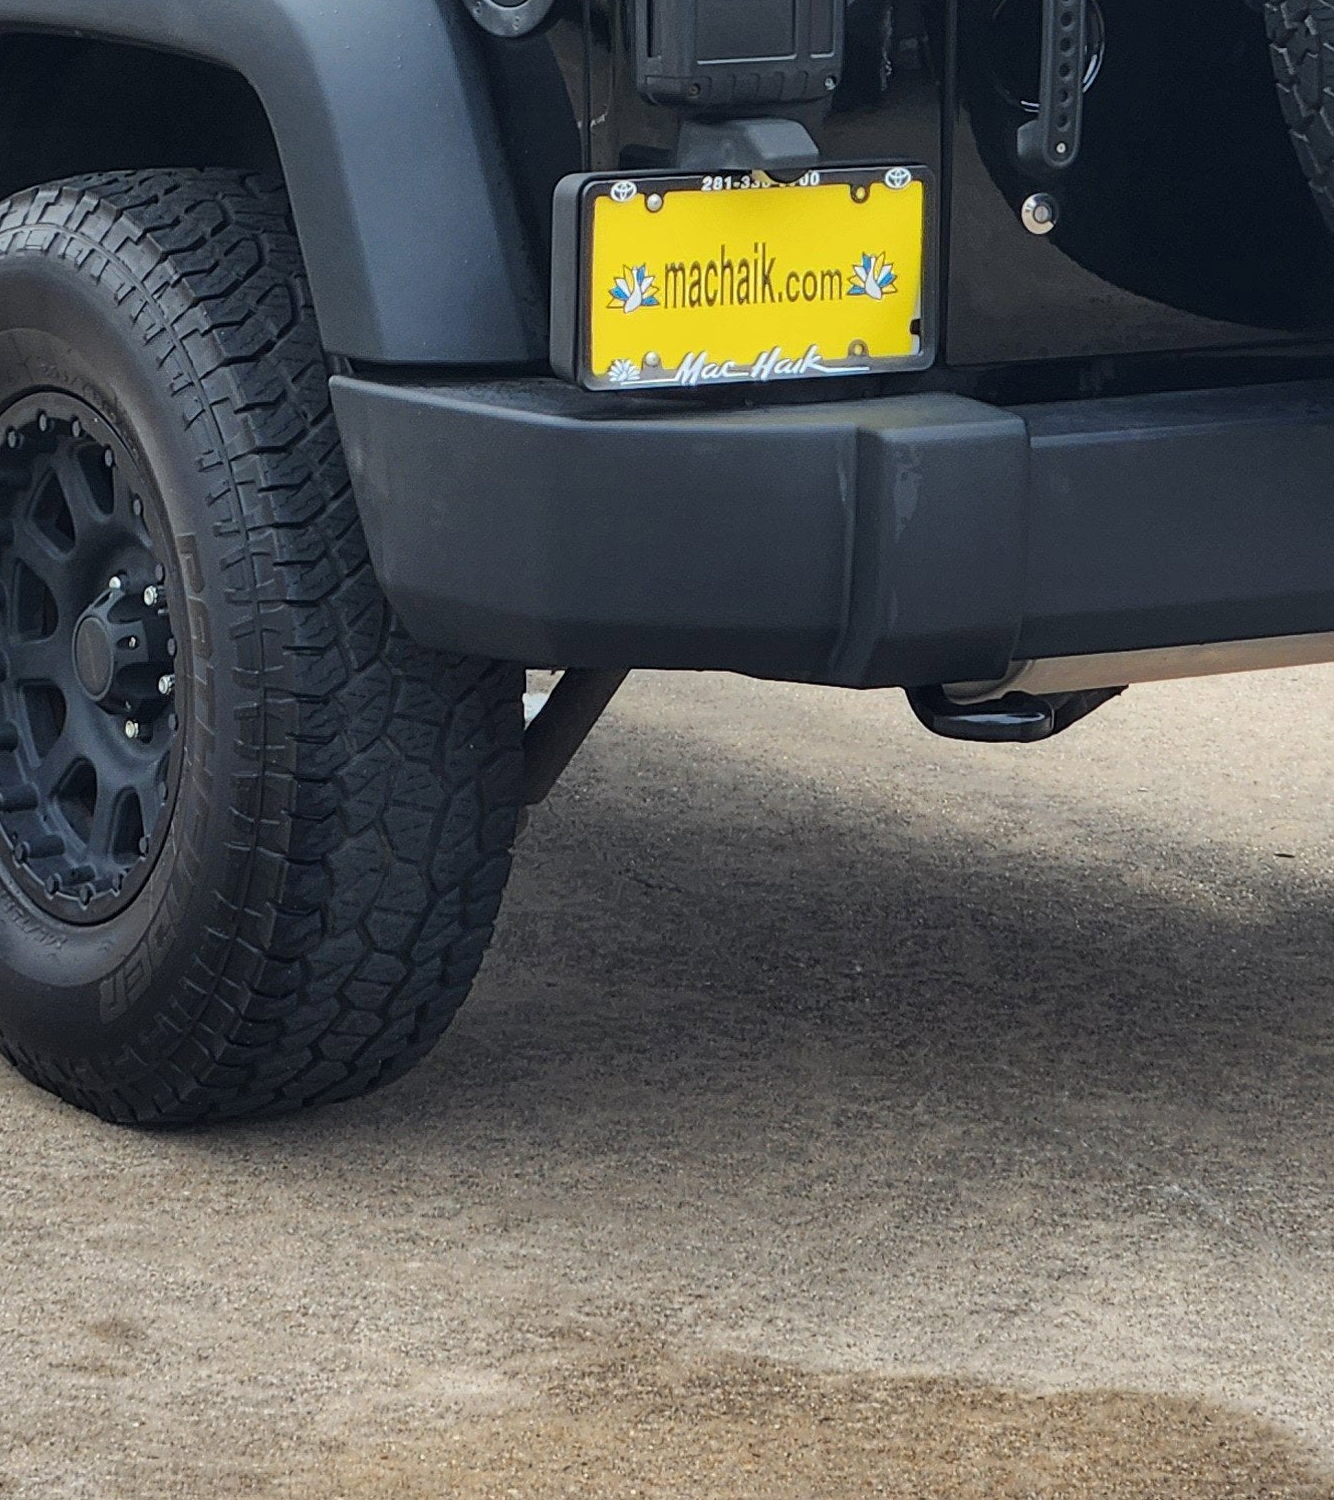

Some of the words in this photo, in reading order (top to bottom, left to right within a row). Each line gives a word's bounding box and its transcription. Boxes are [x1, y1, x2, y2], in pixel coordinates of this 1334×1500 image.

[664, 242, 843, 310] machaik.com
[674, 350, 747, 386] Mac
[749, 343, 827, 381] Haik
